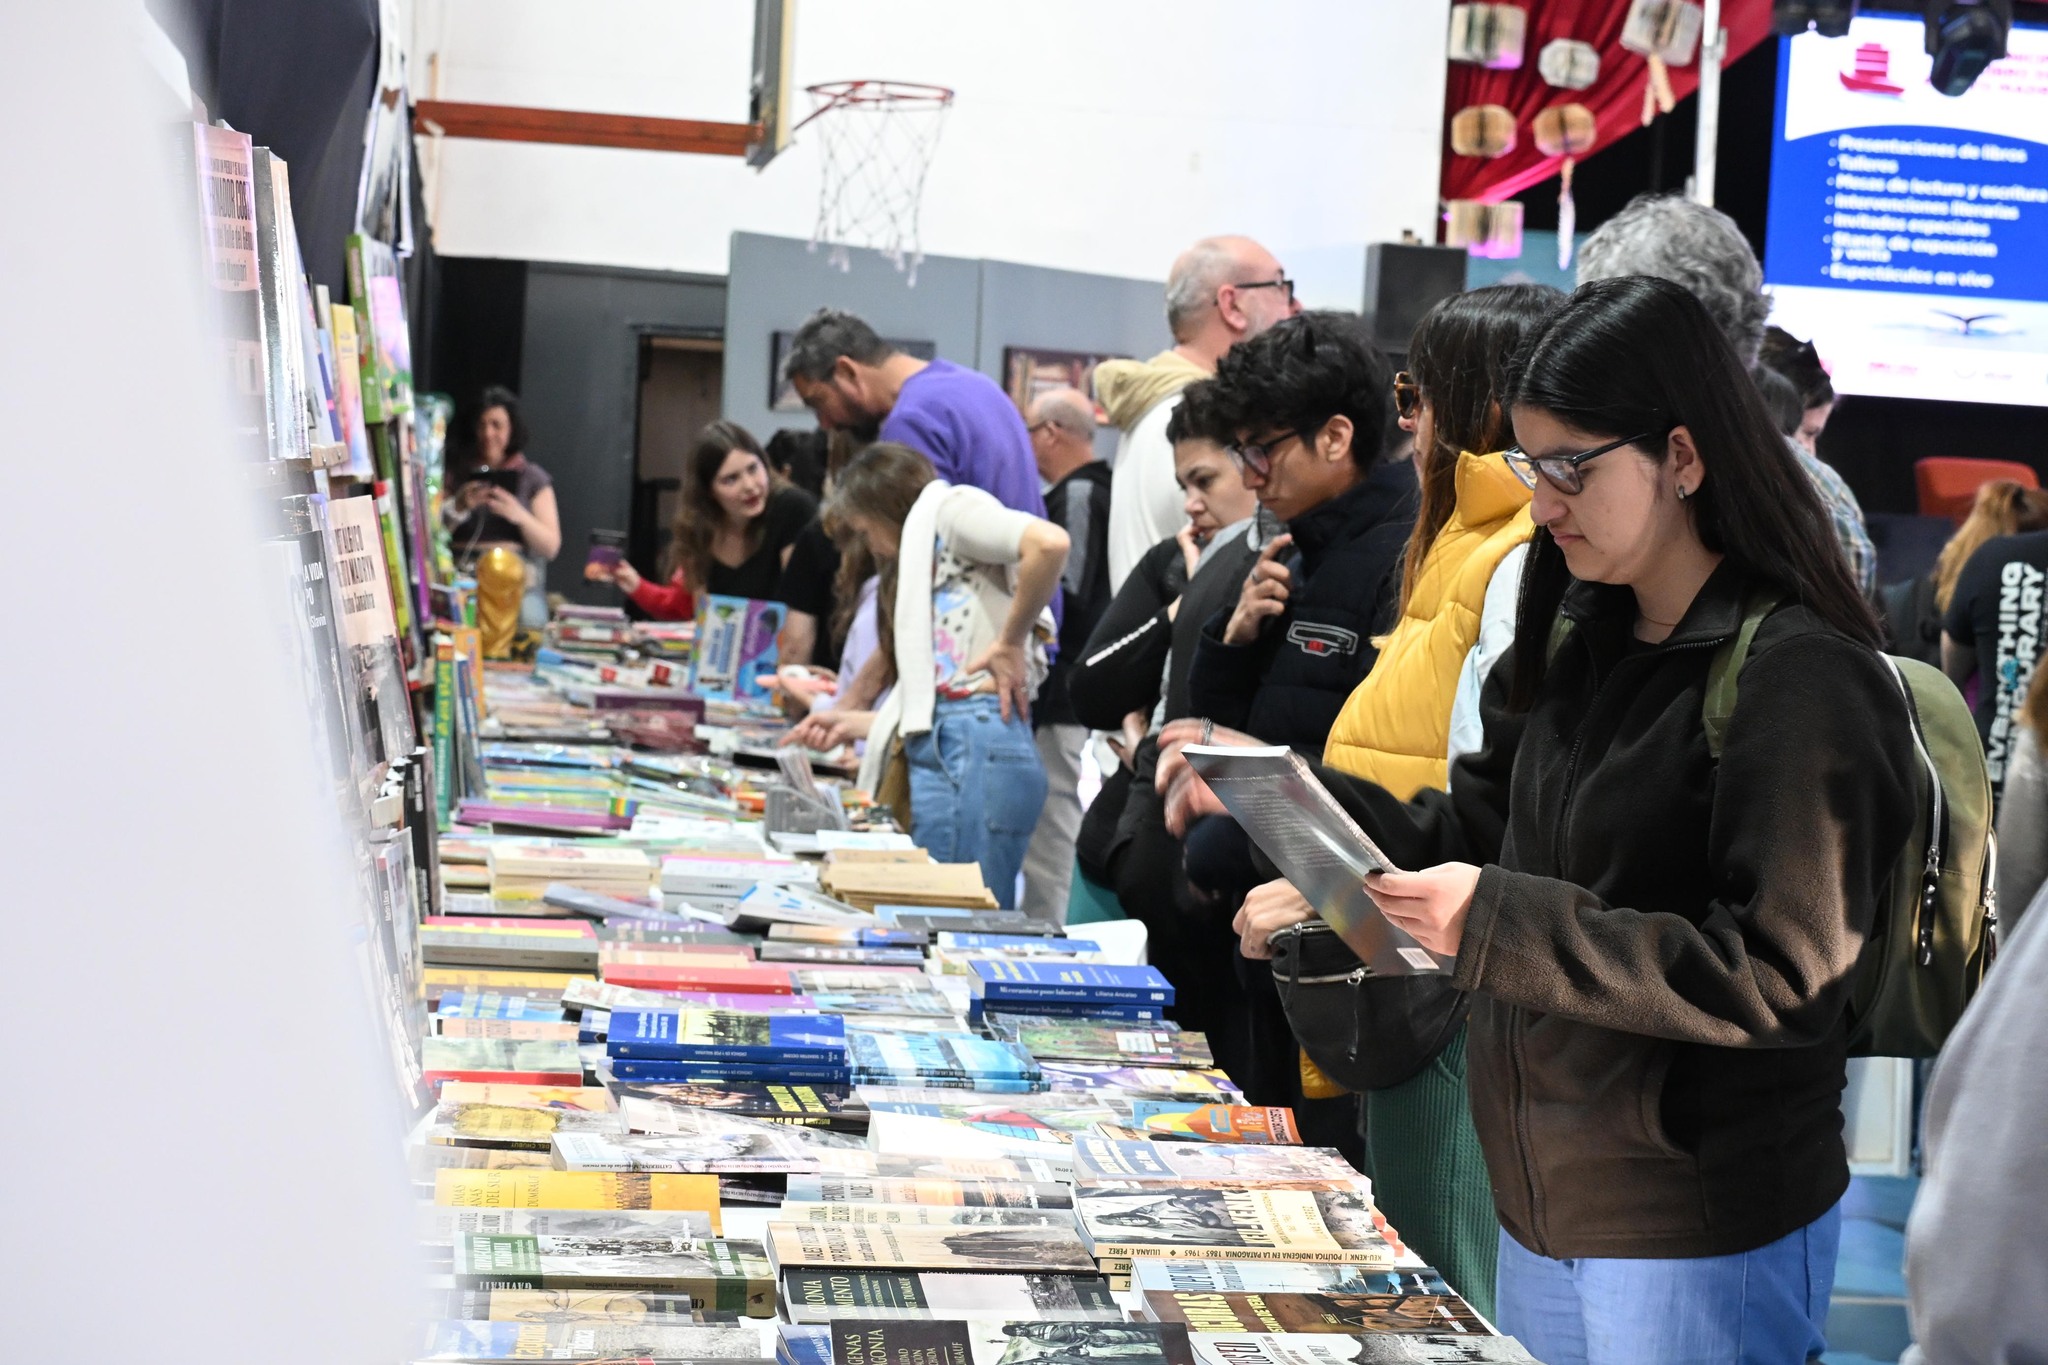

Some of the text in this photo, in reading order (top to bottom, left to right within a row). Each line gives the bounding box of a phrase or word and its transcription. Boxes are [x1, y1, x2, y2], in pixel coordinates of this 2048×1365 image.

[1838, 134, 2028, 163] Presentaciones de libros
[1838, 153, 1898, 174] Talleres
[1887, 176, 1909, 194] de
[1910, 178, 1966, 197] lectura
[1966, 184, 1979, 200] y
[1888, 235, 1911, 252] de
[1934, 271, 1957, 286] en
[1957, 270, 1994, 288] vivo
[308, 561, 325, 581] VIDA
[451, 1184, 467, 1207] TIMAS
[486, 1171, 501, 1204] DEL SUR
[467, 1188, 483, 1207] AÑAS
[1109, 1247, 1128, 1256] PÉREZ
[1128, 1247, 1135, 1255] E.
[1185, 1249, 1200, 1257] 1965
[1207, 1250, 1222, 1258] 1865
[1226, 1250, 1262, 1259] PATAGONIA
[1282, 1252, 1314, 1261] INDÍGENA
[1315, 1252, 1342, 1262] POLÍTICA
[1350, 1253, 1382, 1262] KEU-KENK
[802, 1280, 828, 1314] COLONIA
[898, 1278, 915, 1299] DUMRAUF
[1245, 1295, 1267, 1310] VERA
[1253, 1309, 1272, 1317] DE
[506, 1324, 554, 1359] tagonia
[844, 1333, 865, 1365] GENAS
